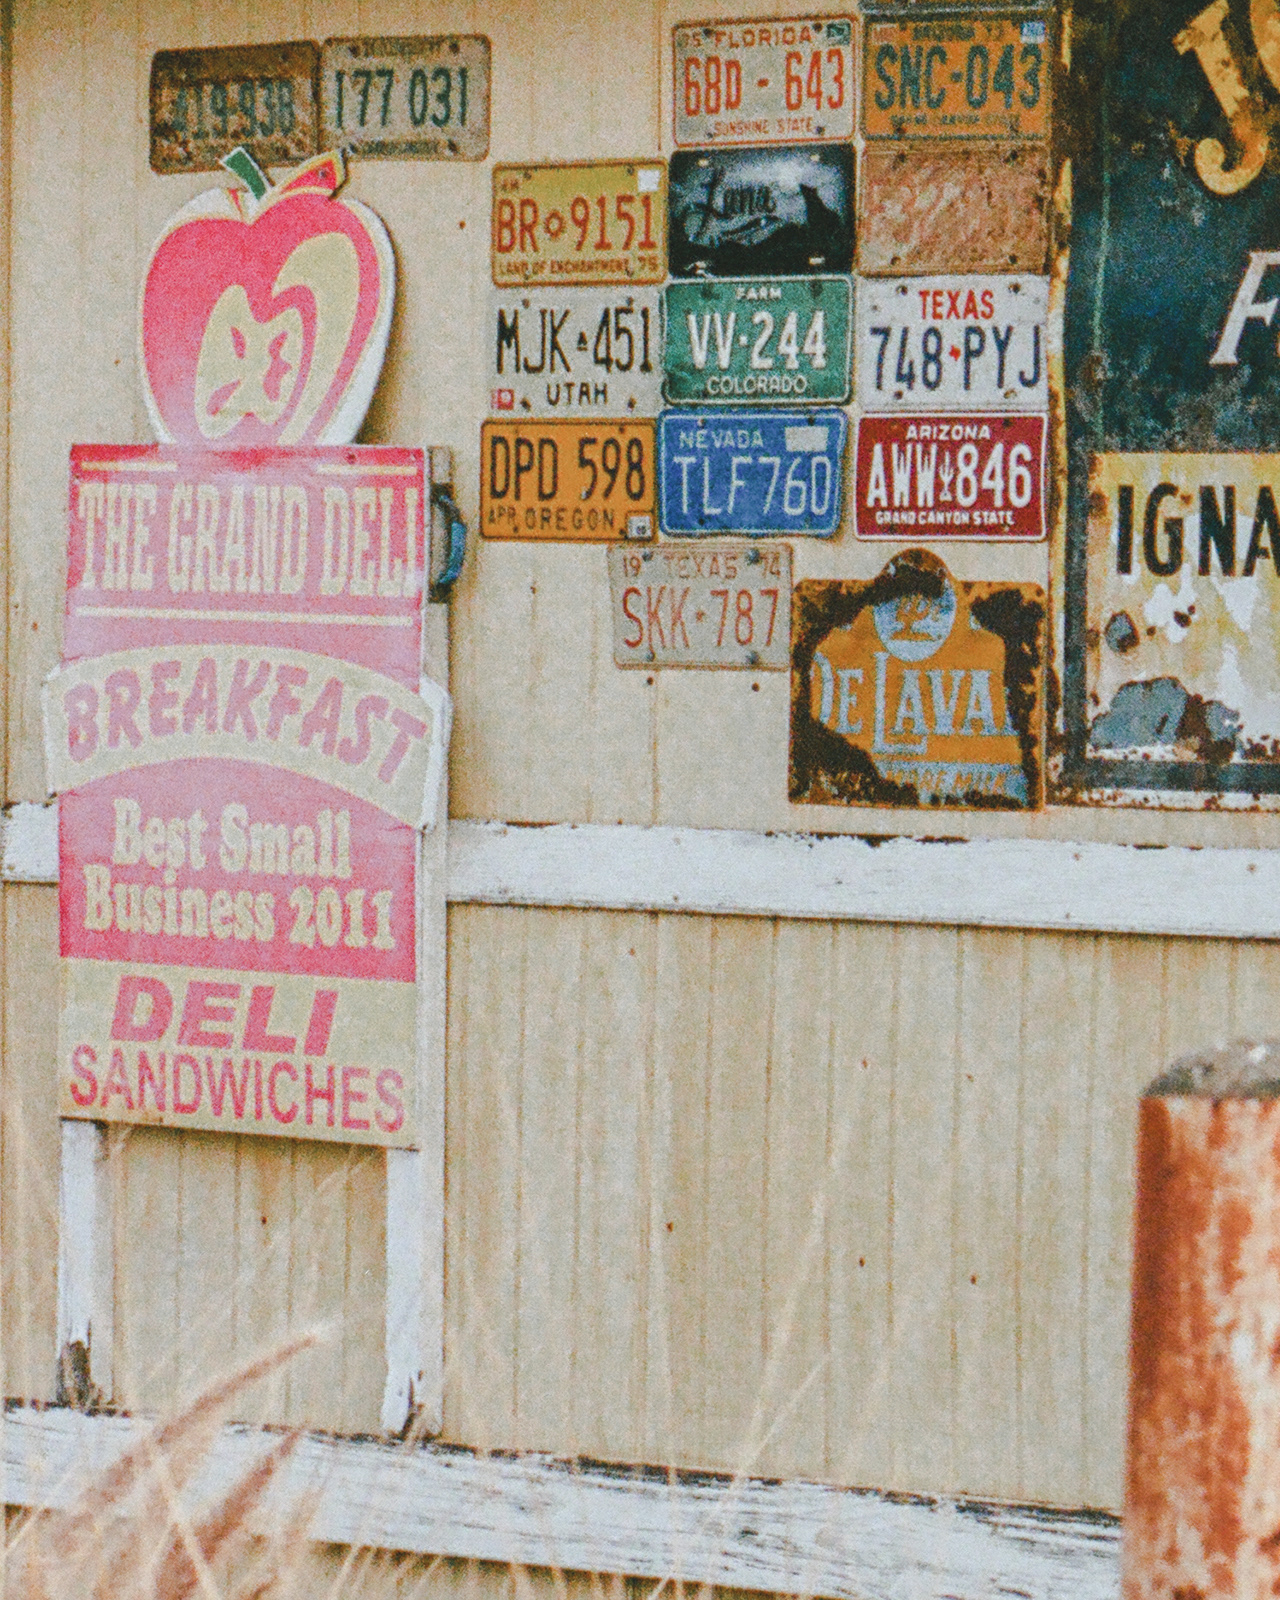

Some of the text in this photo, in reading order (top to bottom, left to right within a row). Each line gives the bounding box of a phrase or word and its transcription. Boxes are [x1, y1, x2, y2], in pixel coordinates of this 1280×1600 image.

[714, 26, 812, 49] FLORIDA
[408, 65, 468, 127] 031
[683, 55, 742, 117] 68D
[784, 47, 845, 113] 643
[570, 193, 658, 252] 9151
[734, 286, 783, 301] FARM
[918, 289, 996, 321] TEXAS
[495, 306, 653, 374] MJK 451
[869, 325, 1042, 391] 748 PYJ
[546, 382, 609, 406] UTAH
[706, 375, 809, 397] COLORADO
[678, 429, 766, 450] NEVADA
[905, 423, 992, 442] ARIZONA
[490, 435, 647, 502] DPD 598
[956, 442, 1034, 508] 846
[77, 480, 420, 598] THE GRAND DELI
[487, 506, 517, 525] APR
[524, 507, 615, 531] OREGON
[875, 510, 1015, 526] GRAND CANYON STATE
[621, 554, 642, 578] 19
[663, 553, 739, 580] TEXAS
[621, 585, 780, 650] SKK 787
[62, 656, 429, 785] BREAKFAST
[113, 797, 354, 880] Best Small
[82, 864, 396, 950] Business 2011
[109, 974, 340, 1057] DELI
[69, 1044, 406, 1134] SANDWICHES
